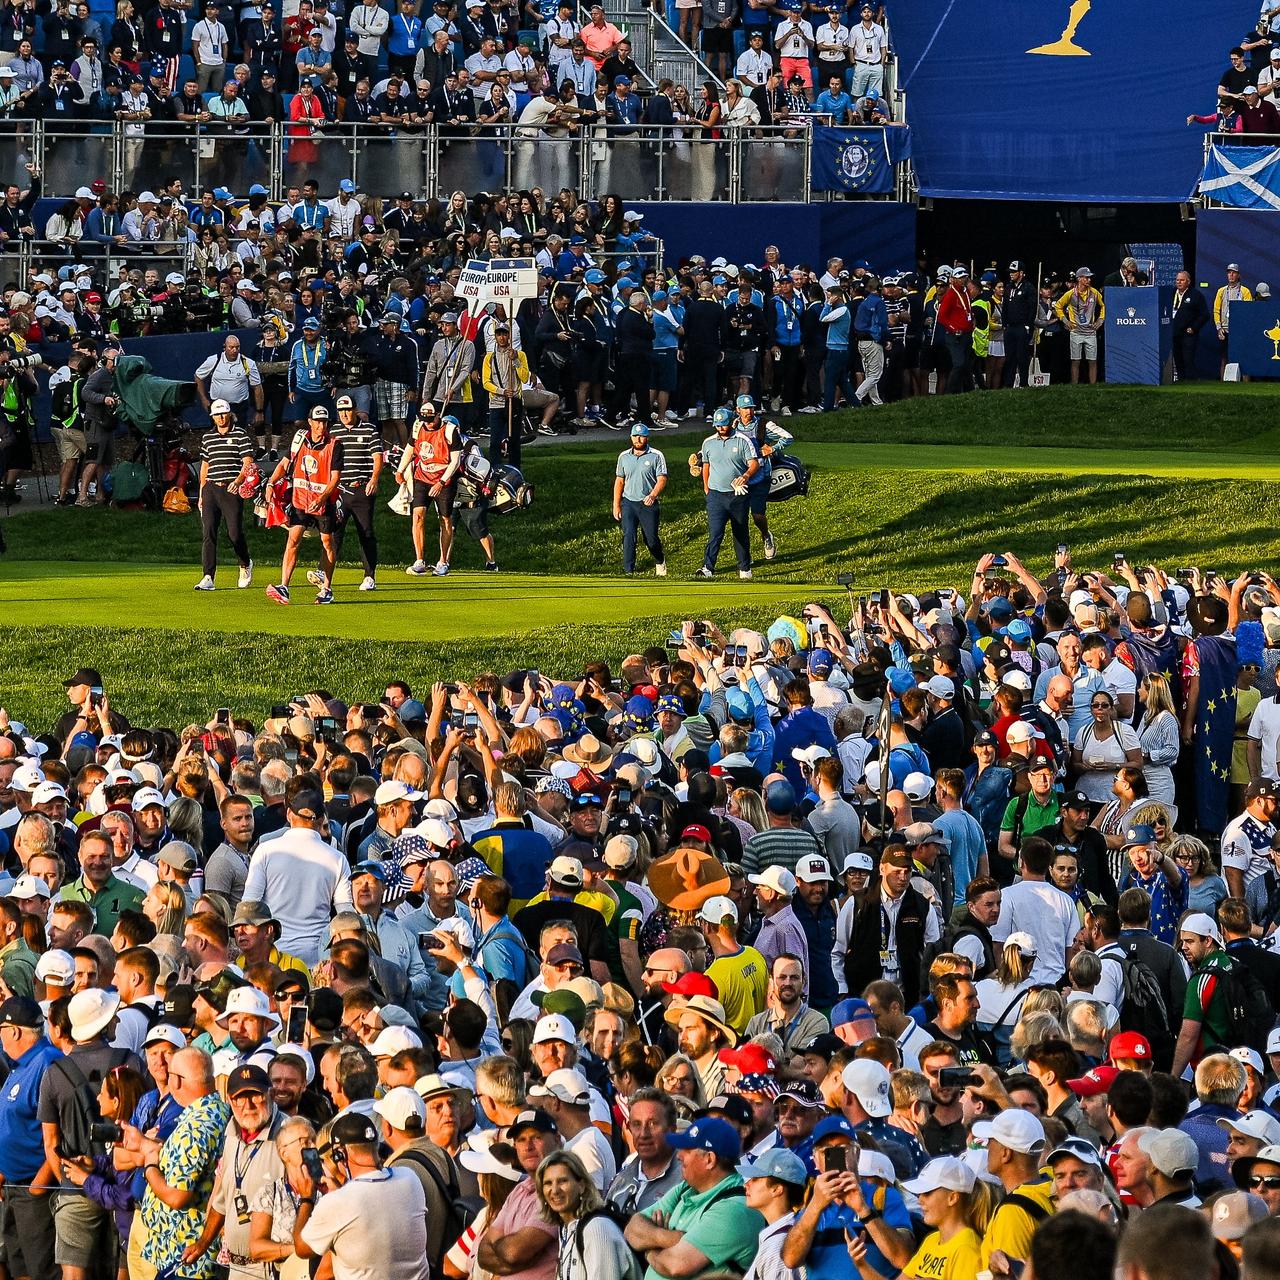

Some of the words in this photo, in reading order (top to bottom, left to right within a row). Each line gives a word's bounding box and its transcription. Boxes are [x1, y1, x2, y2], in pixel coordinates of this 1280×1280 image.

[487, 272, 518, 283] EUROPE
[463, 285, 479, 296] USA
[494, 286, 510, 296] USA
[771, 471, 792, 486] OPE
[786, 1082, 807, 1094] USA
